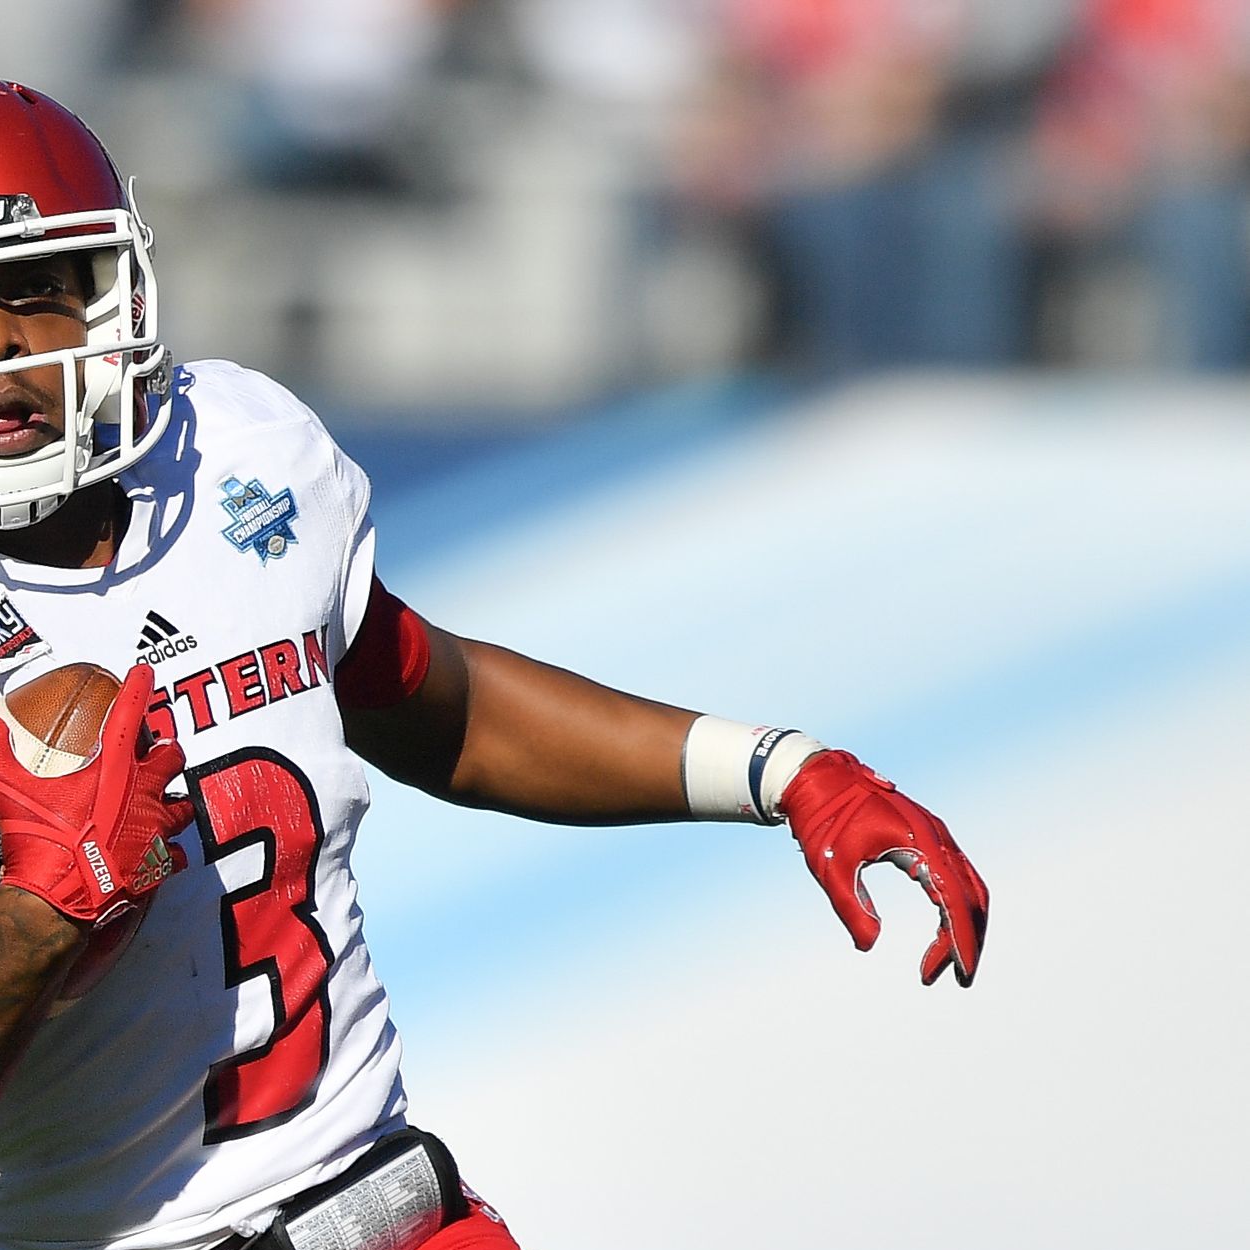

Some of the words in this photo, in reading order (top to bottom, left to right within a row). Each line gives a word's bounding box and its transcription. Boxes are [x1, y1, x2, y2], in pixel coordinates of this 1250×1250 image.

[233, 497, 291, 543] CHAMPIONSHIP
[136, 634, 198, 665] adidas
[147, 623, 332, 743] STERN
[184, 746, 335, 1146] 3
